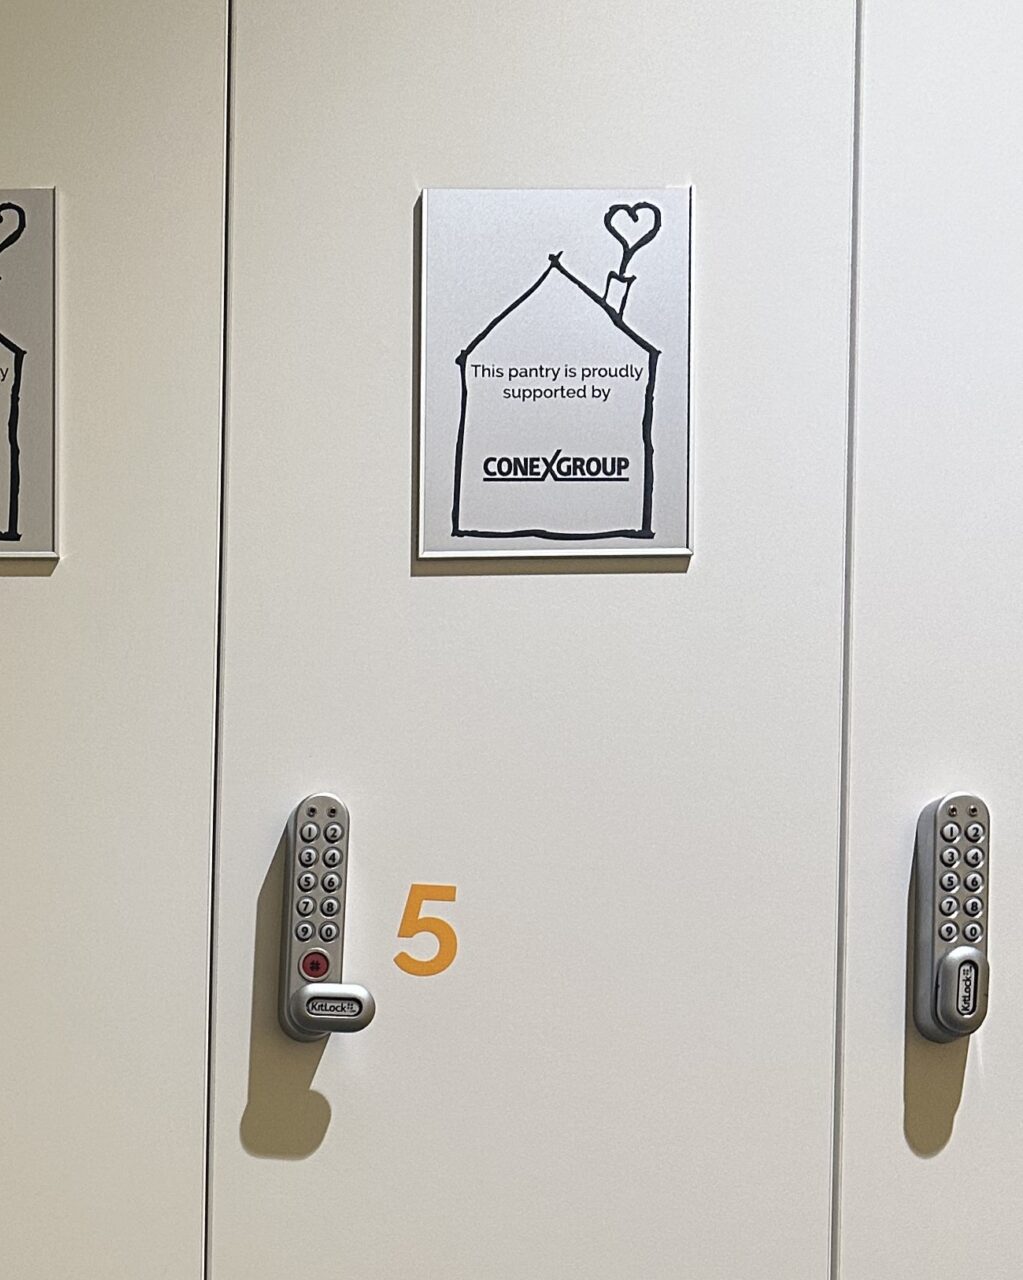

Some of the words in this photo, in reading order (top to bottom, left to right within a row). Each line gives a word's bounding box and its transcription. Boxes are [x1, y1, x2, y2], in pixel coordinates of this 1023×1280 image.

[471, 364, 504, 378] This
[508, 366, 560, 381] pantry
[565, 364, 576, 378] is
[581, 364, 643, 381] proudly
[503, 385, 586, 402] supported
[592, 385, 611, 402] by
[307, 827, 312, 838] 1
[330, 828, 337, 838] 2
[950, 827, 953, 838] 1
[973, 827, 979, 837] 2
[305, 852, 312, 863] 3
[328, 853, 336, 863] 4
[948, 852, 954, 862] 3
[972, 852, 979, 862] 4
[303, 877, 311, 888] 5
[327, 877, 335, 888] 6
[947, 876, 954, 887] 5
[971, 877, 978, 887] 6
[302, 901, 309, 912] 7
[326, 902, 334, 913] 8
[946, 901, 953, 912] 7
[971, 902, 978, 912] 8
[301, 926, 309, 937] 9
[325, 927, 332, 938] 0
[396, 885, 456, 975] 5
[946, 926, 953, 937] 9
[970, 927, 977, 937] 0
